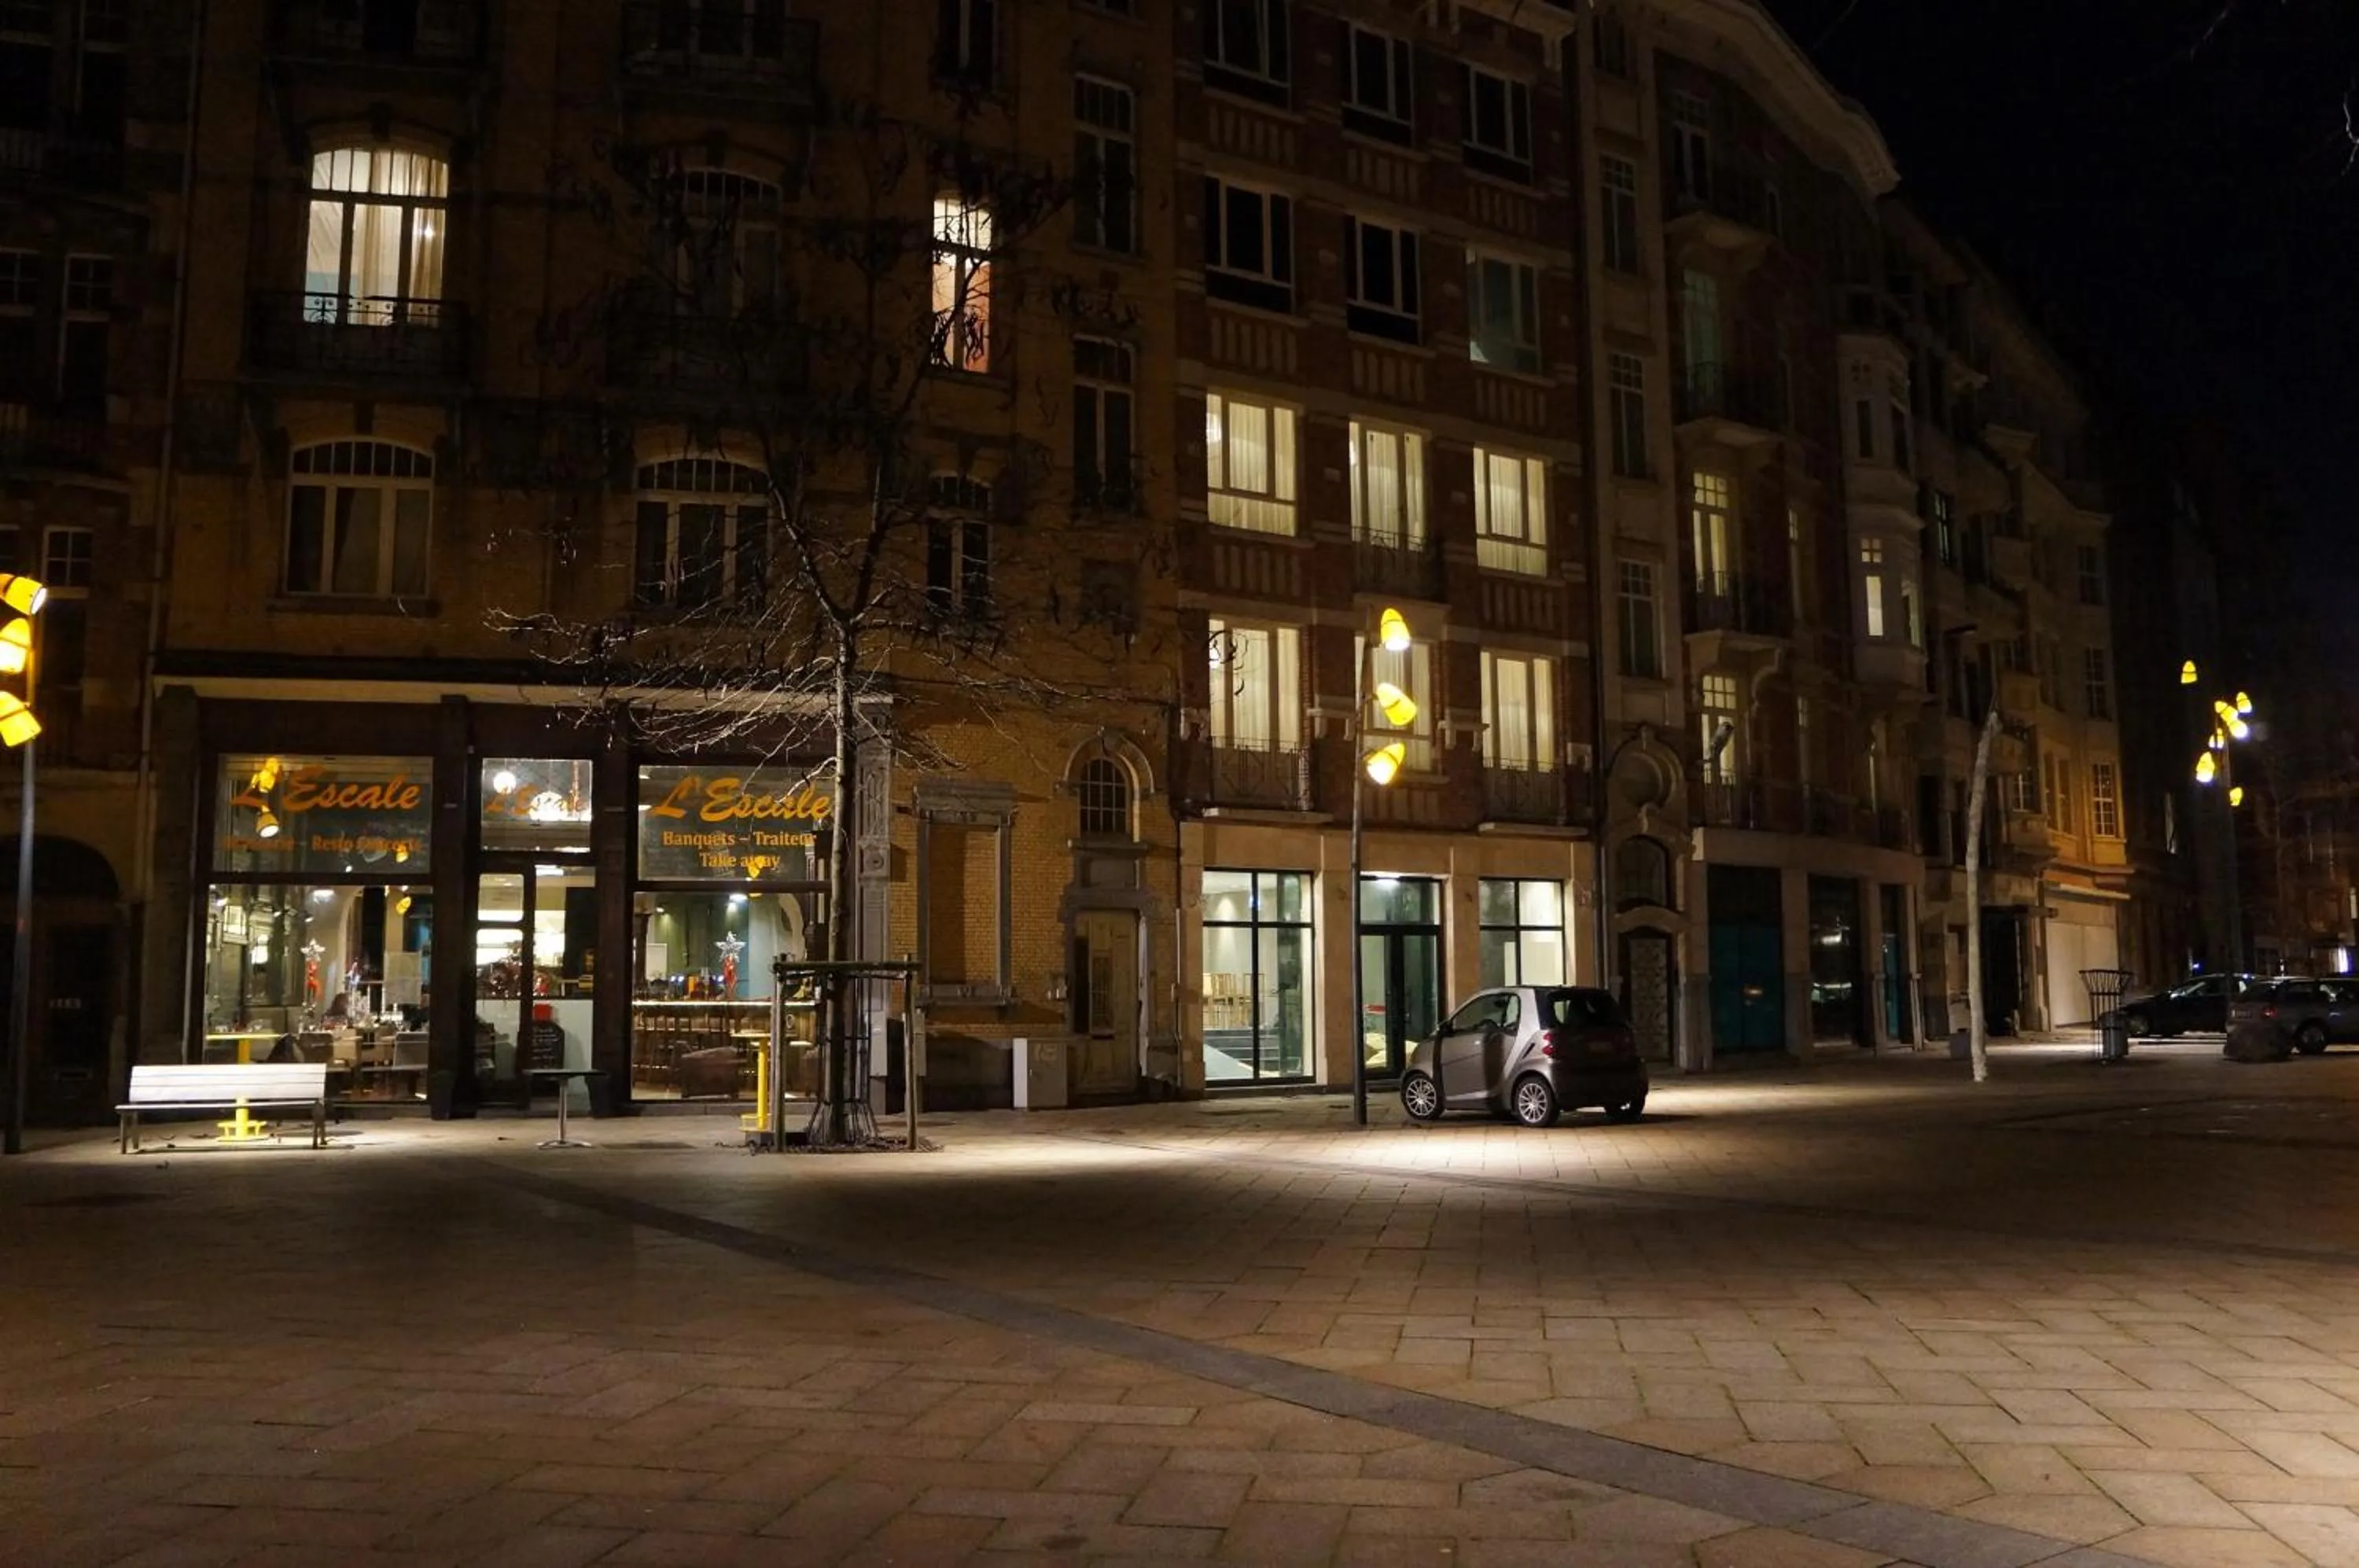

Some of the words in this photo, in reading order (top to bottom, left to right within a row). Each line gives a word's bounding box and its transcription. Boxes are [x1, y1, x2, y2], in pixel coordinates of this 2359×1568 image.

[650, 775, 831, 822] L'Escale
[662, 830, 736, 849] Banquets
[752, 830, 817, 846] Traiteur
[699, 852, 737, 867] Take
